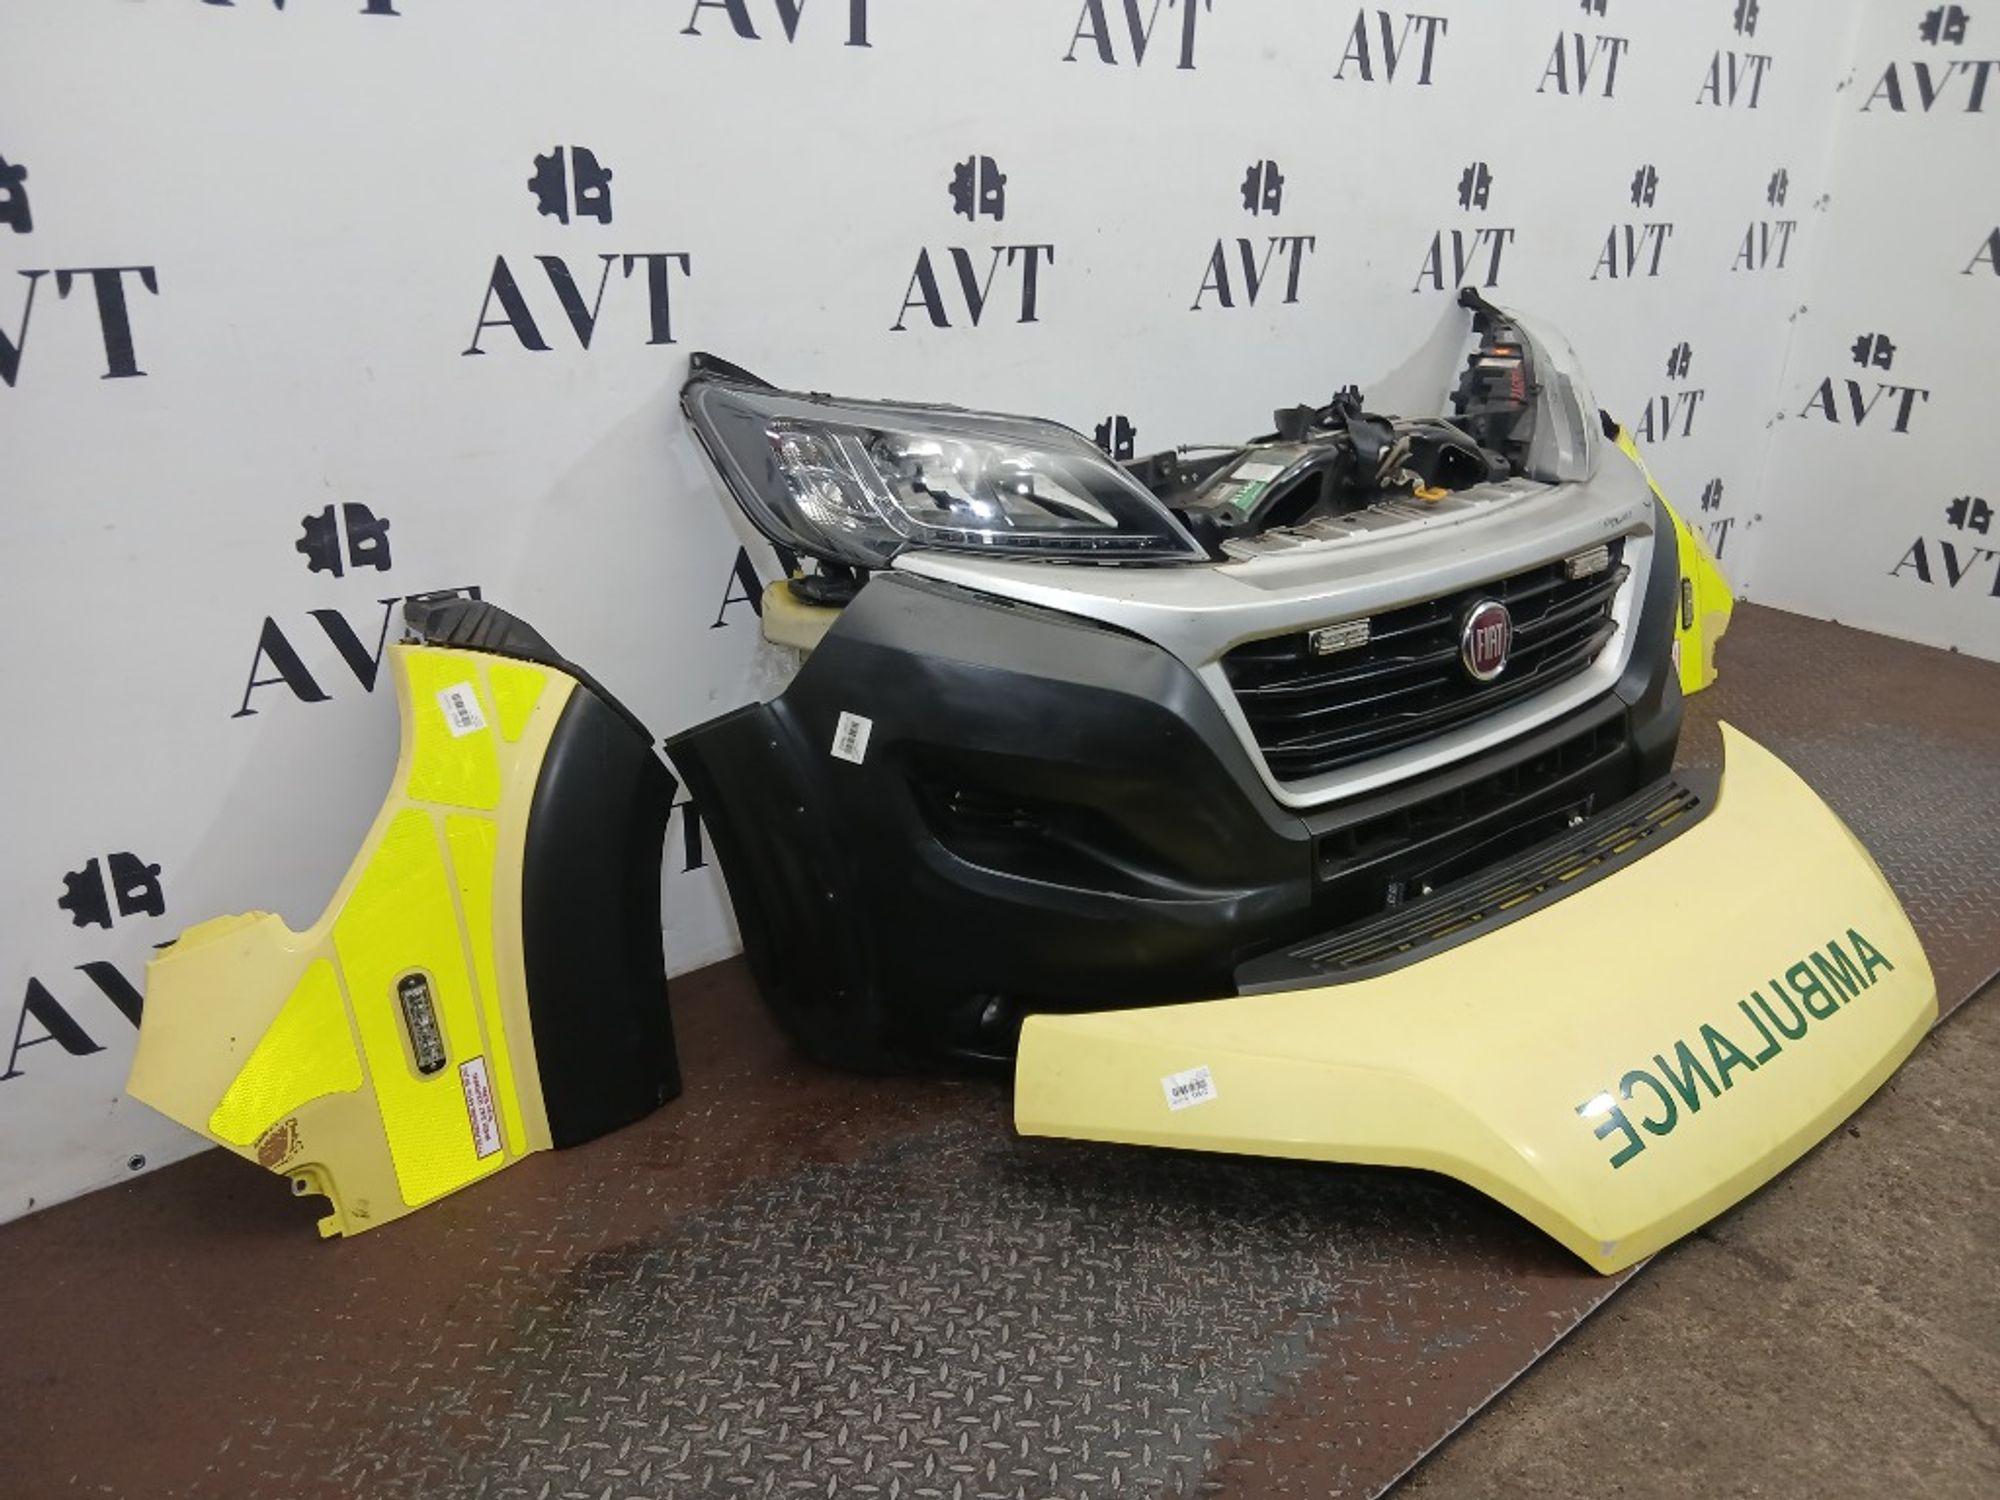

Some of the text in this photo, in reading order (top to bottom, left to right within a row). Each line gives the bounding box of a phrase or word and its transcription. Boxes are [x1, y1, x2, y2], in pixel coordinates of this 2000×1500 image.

[1062, 0, 1212, 70] AVT
[1333, 7, 1448, 85] AVT
[1536, 30, 1629, 98] AVT
[1696, 50, 1772, 109] AVT
[1859, 60, 2000, 113] AVT
[1190, 235, 1316, 311] AVT
[1412, 228, 1515, 293] AVT
[1590, 222, 1673, 281] AVT
[1732, 220, 1797, 271] AVT
[461, 252, 691, 356] AVT
[889, 244, 1054, 331] AVT
[1633, 388, 1705, 446] AVT
[1798, 376, 1930, 434] AVT
[1476, 623, 1503, 663] FIAT
